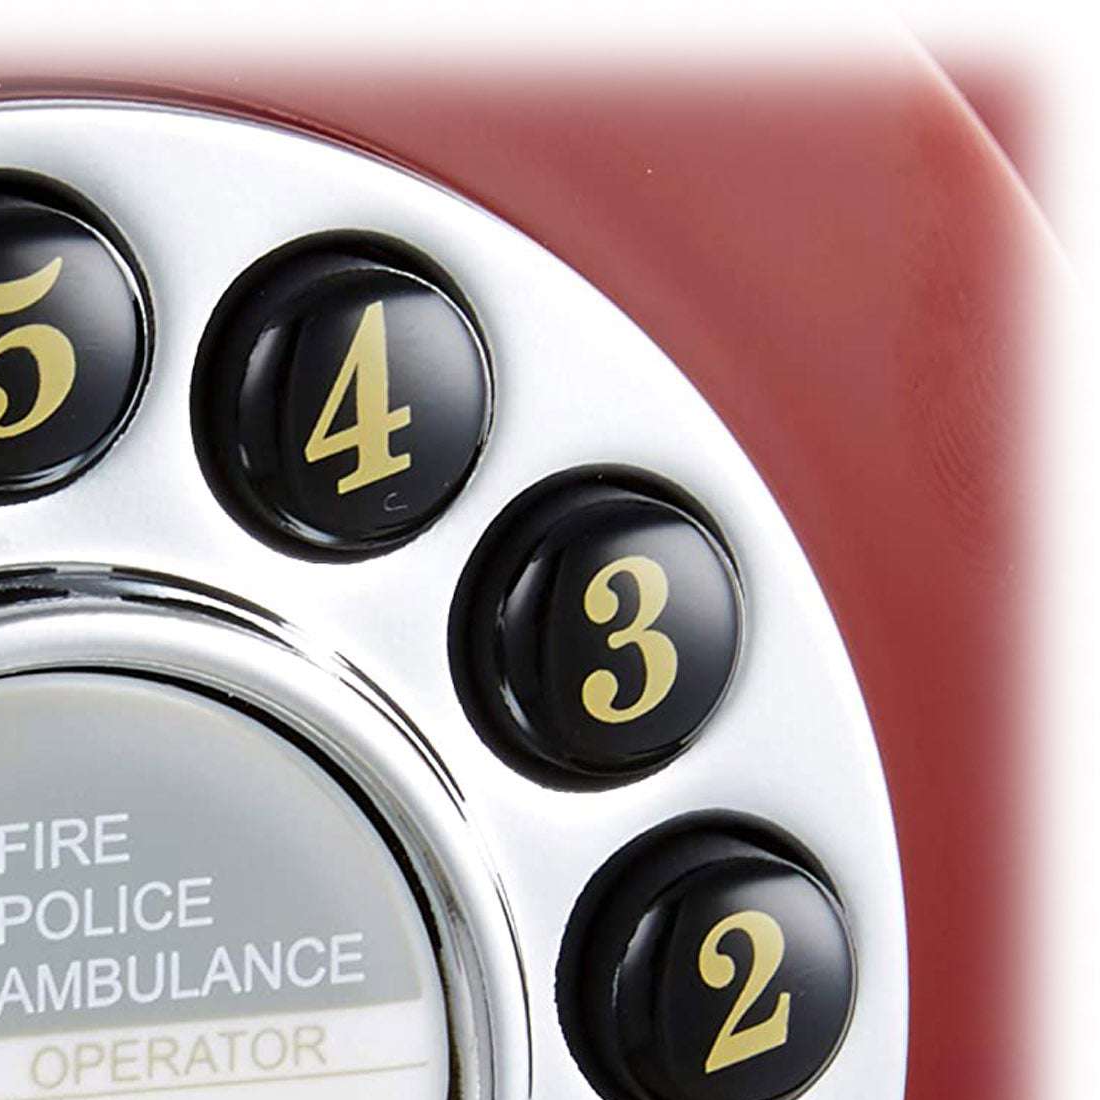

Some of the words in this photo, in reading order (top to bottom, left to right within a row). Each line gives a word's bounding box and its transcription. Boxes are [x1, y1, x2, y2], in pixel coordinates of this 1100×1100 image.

[304, 300, 412, 495] 4
[580, 555, 676, 725] 3
[29, 1024, 329, 1092] OPERATOR
[697, 911, 790, 1073] 2
